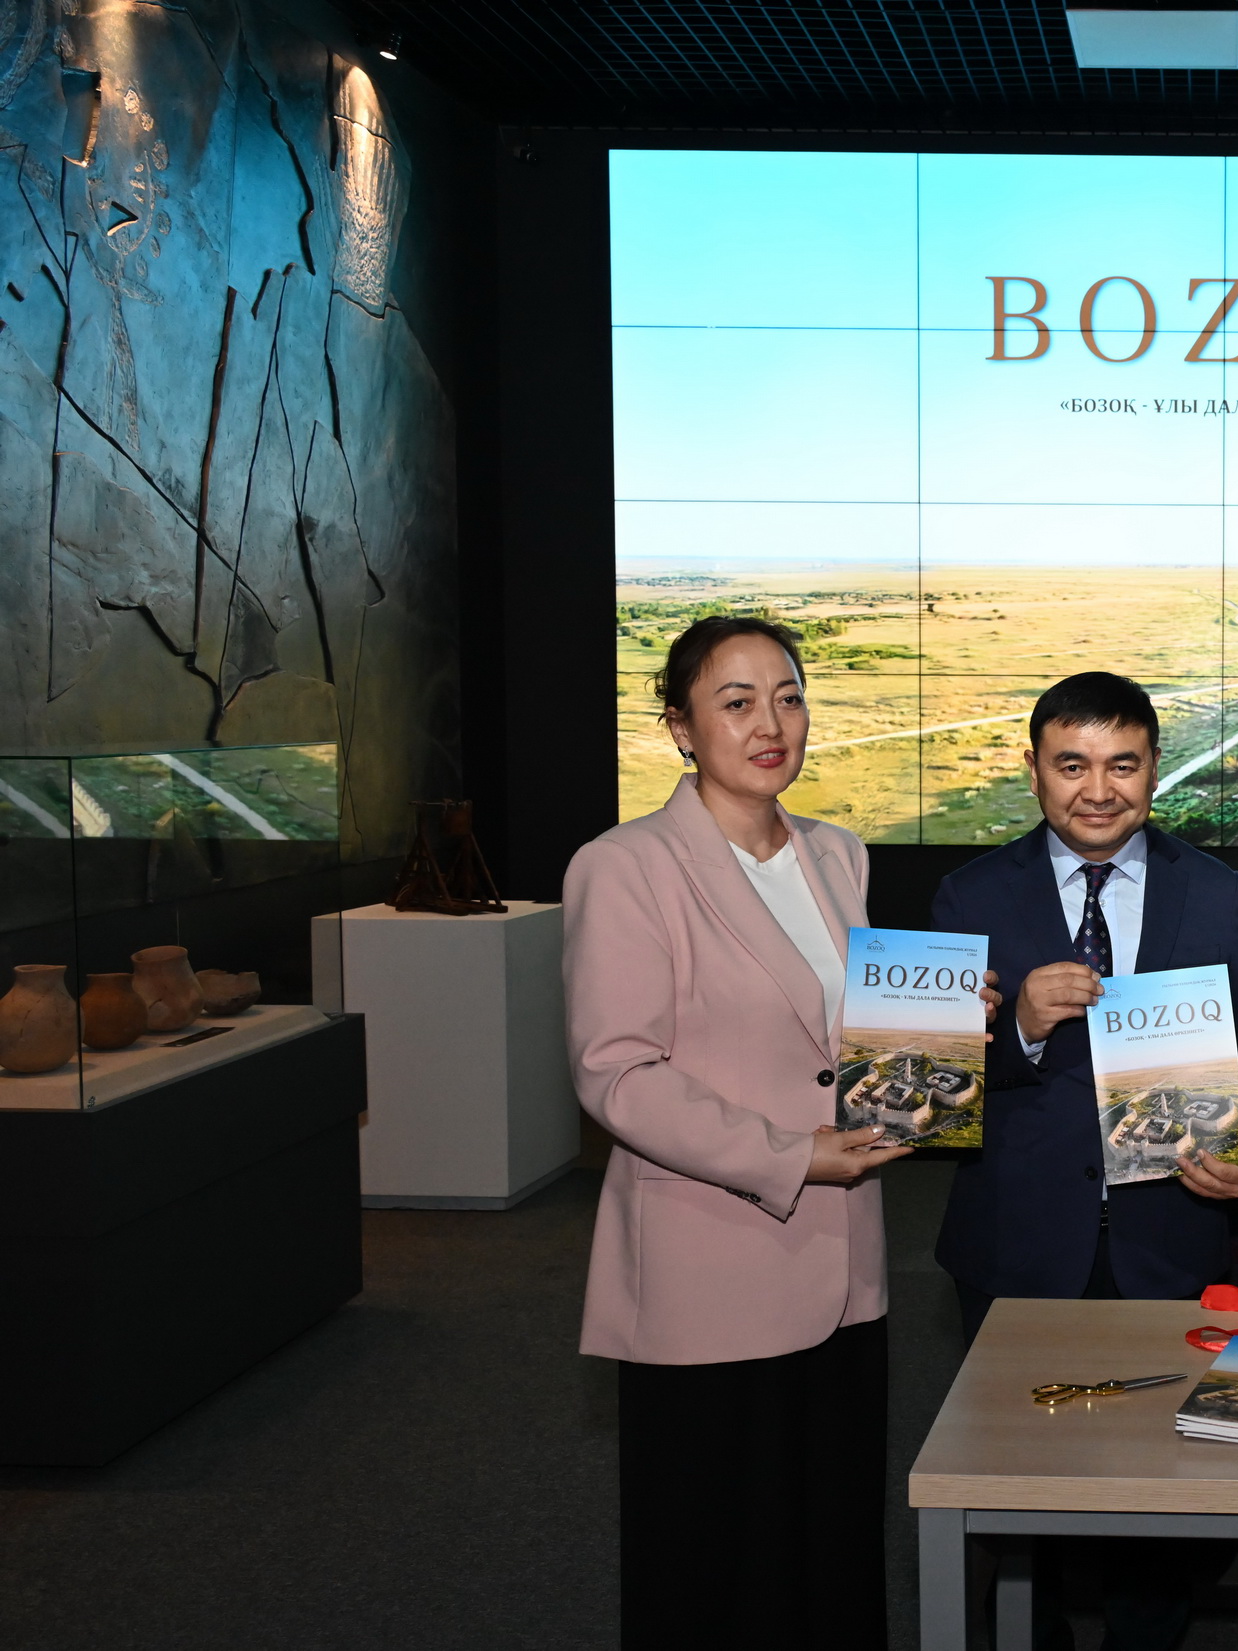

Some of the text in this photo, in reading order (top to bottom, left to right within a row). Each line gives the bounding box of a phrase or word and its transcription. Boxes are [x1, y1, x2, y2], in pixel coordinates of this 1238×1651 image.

[1060, 398, 1138, 416] «БОЗОҚ
[1153, 398, 1199, 414] ҰЛЫ
[863, 962, 978, 994] BOZOQ
[1104, 999, 1223, 1034] BOZOQ
